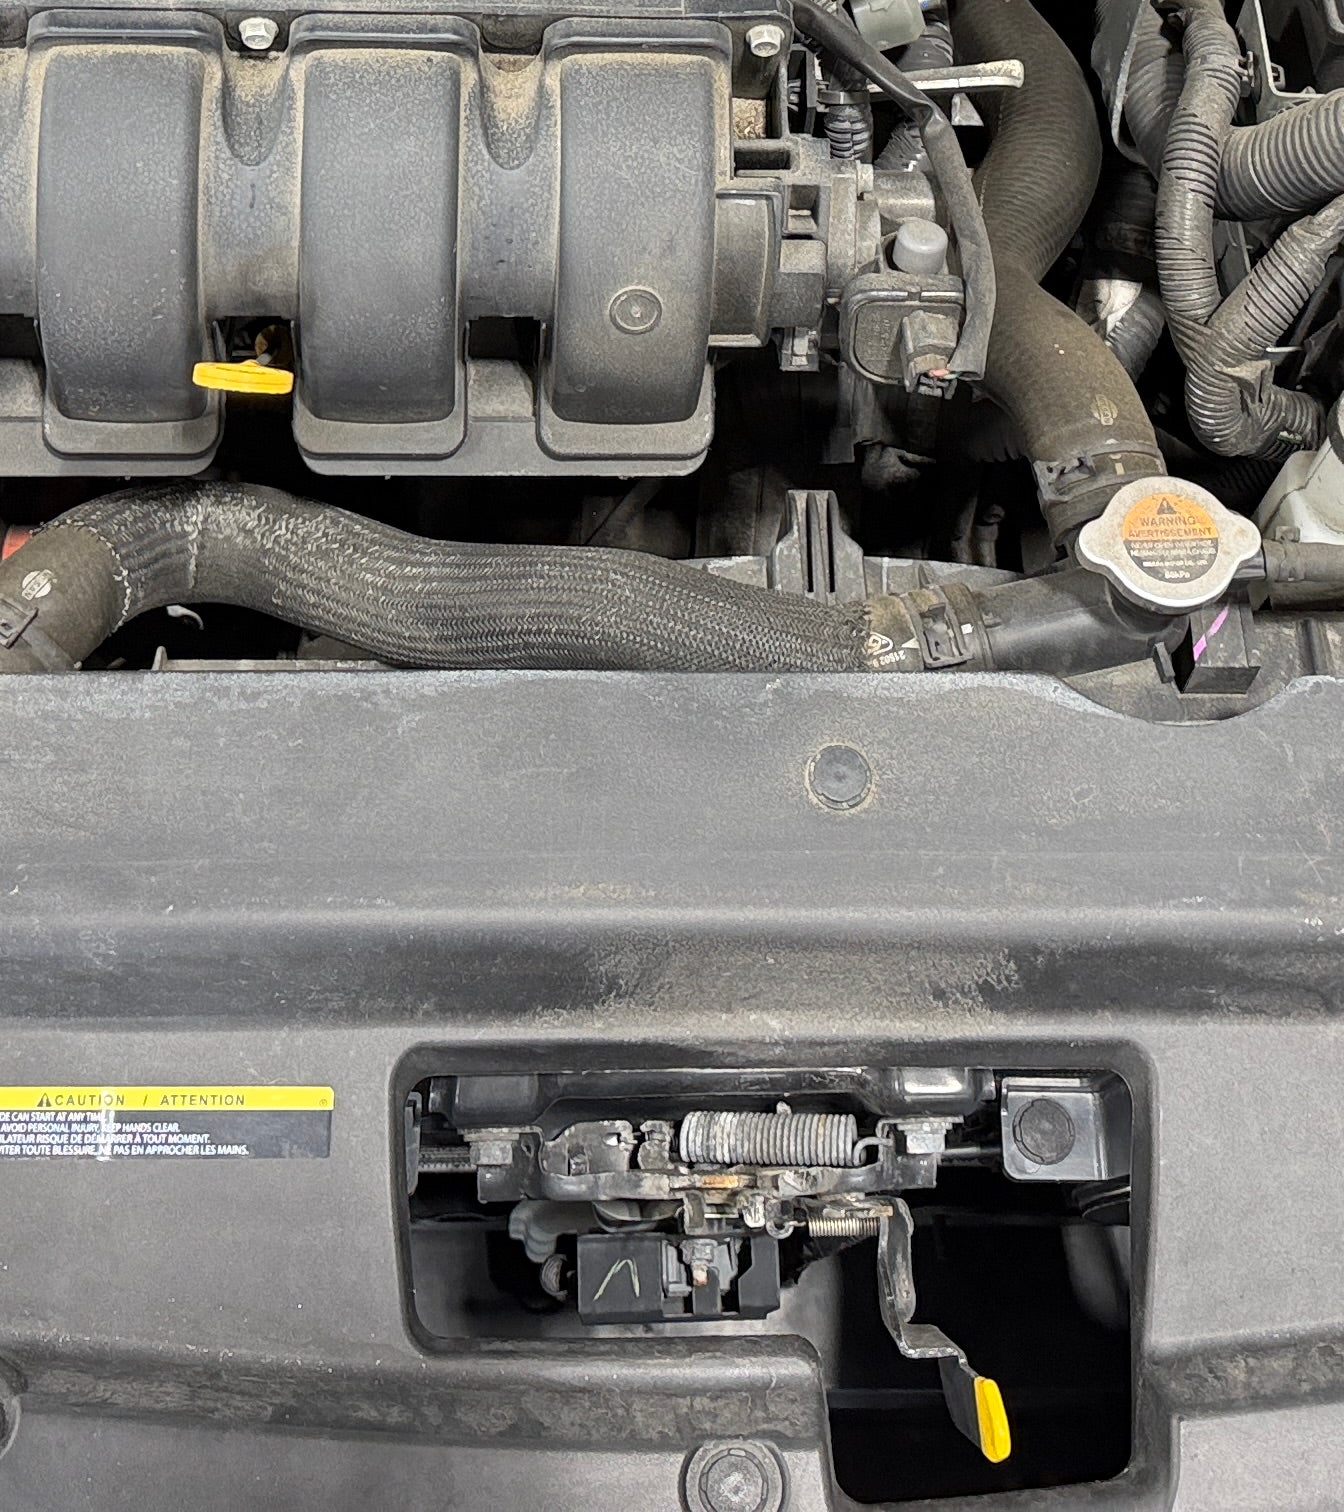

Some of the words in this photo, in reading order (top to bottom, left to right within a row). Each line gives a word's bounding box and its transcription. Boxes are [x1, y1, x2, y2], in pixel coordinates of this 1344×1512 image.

[1141, 515, 1196, 527] WARNING
[1128, 527, 1212, 538] AVERTISSEMENT
[55, 1094, 125, 1107] CAUTION
[142, 1094, 148, 1107] /
[160, 1094, 245, 1106] ATTENTION
[11, 1111, 30, 1122] CAN
[31, 1111, 56, 1122] START
[57, 1111, 67, 1122] AT
[67, 1111, 85, 1122] ANY
[0, 1122, 26, 1133] AVOID
[27, 1122, 69, 1133] PERSONAL
[122, 1122, 152, 1133] HANDS
[152, 1122, 180, 1133] CLEAR.
[36, 1133, 69, 1145] RISQUE
[70, 1133, 83, 1144] DE
[142, 1133, 168, 1144] TOUT
[168, 1133, 211, 1144] MOMENT.
[22, 1144, 51, 1156] TOUTE
[113, 1144, 130, 1156] PAS
[131, 1144, 144, 1156] EN
[145, 1144, 200, 1156] APPROCHER
[200, 1144, 216, 1156] LES
[217, 1144, 250, 1156] MAINS.
